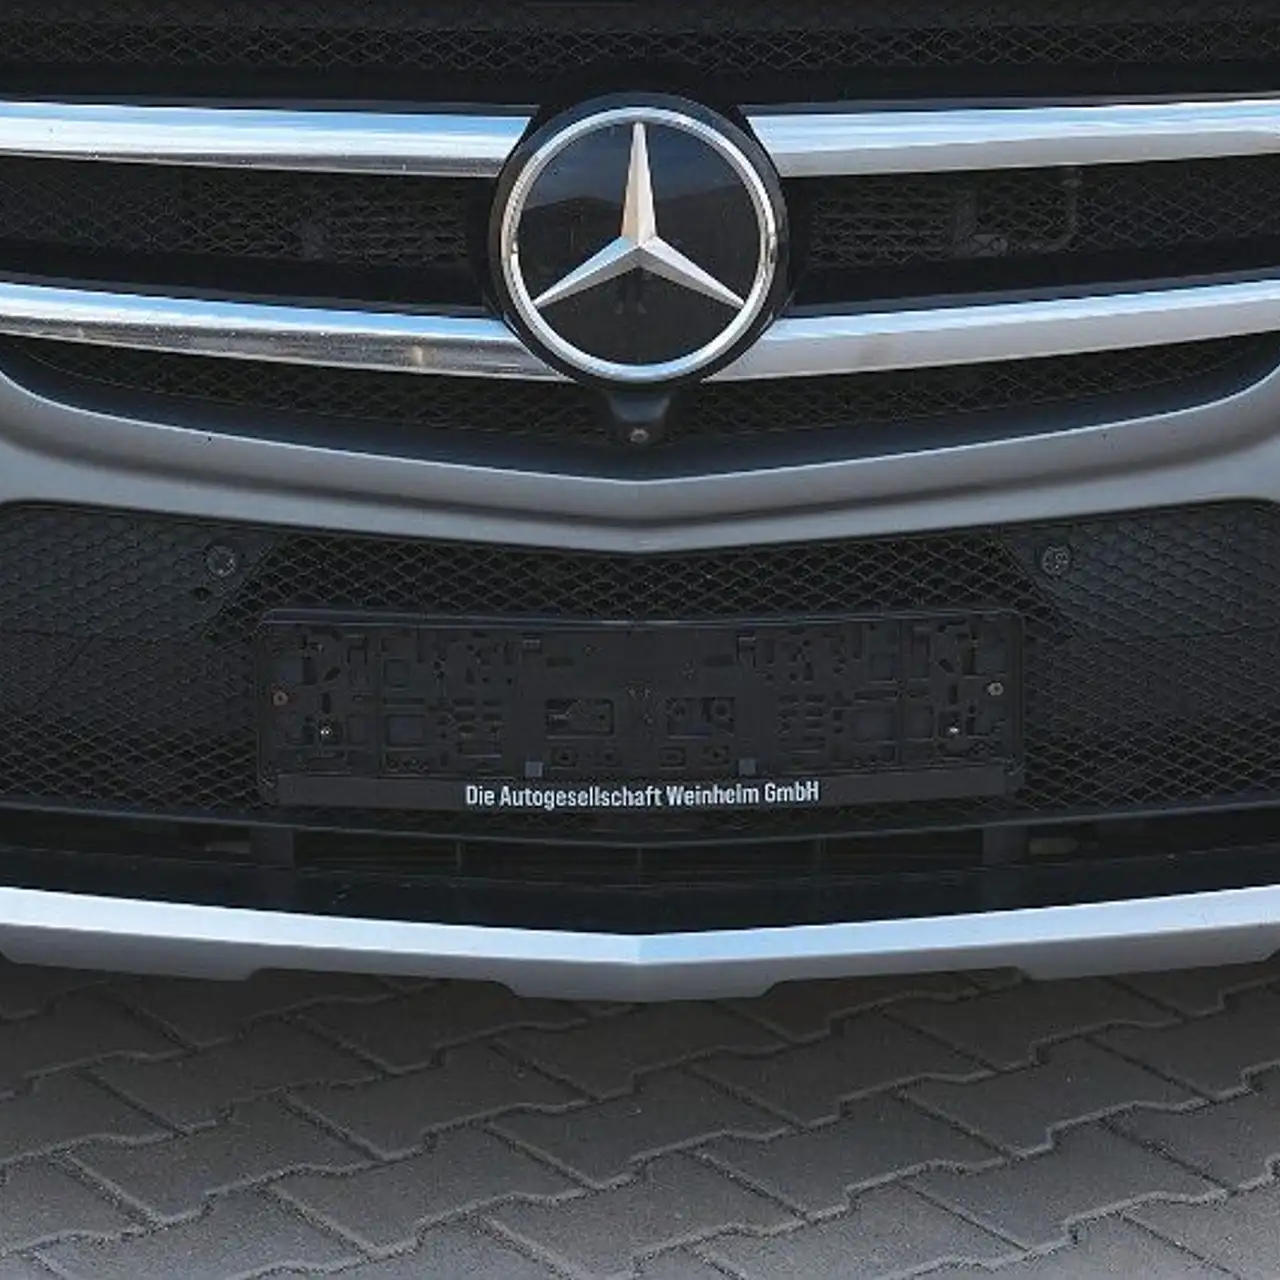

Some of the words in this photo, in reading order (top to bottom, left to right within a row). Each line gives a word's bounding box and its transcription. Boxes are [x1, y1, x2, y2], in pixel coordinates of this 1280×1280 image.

[466, 785, 495, 806] Die
[499, 785, 663, 811] Autogesellschaft
[666, 783, 760, 806] Weinheim
[764, 780, 819, 803] GmbH
